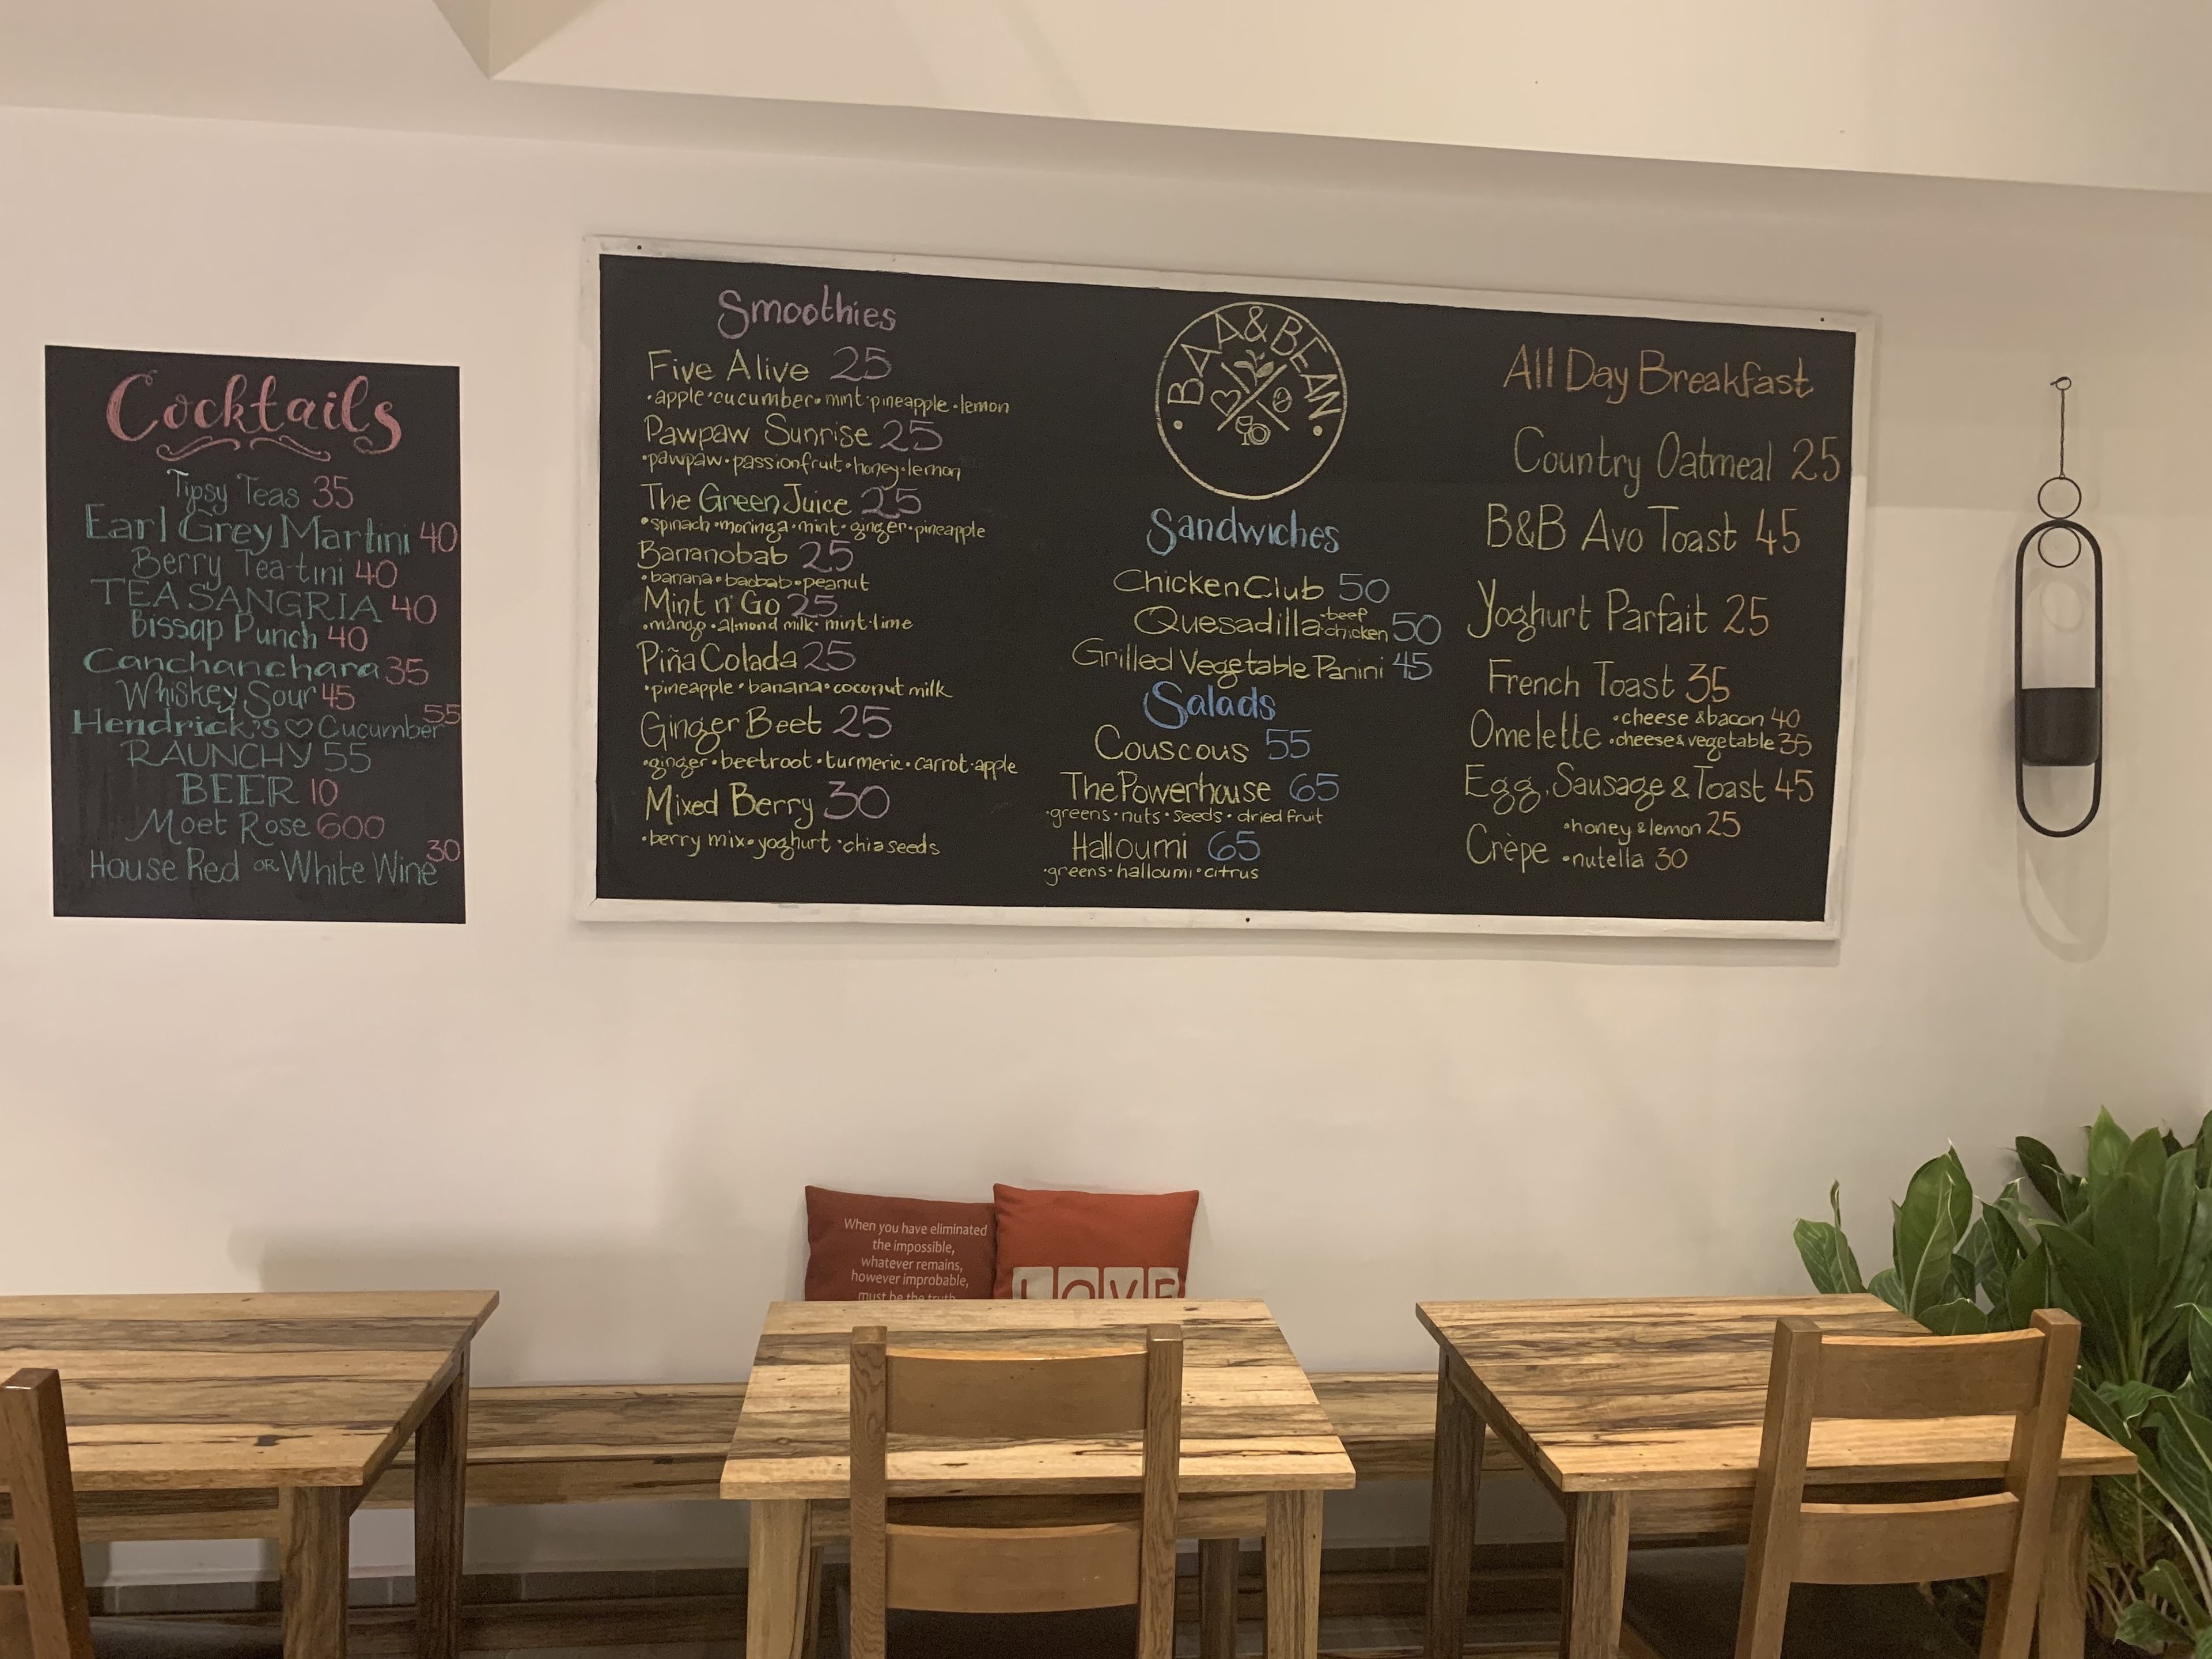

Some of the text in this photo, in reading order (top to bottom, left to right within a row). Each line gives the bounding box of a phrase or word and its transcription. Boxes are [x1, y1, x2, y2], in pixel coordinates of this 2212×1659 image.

[717, 284, 896, 340] Smoothies
[647, 346, 892, 384] Five Alive 25
[1502, 343, 1815, 405] All Day Breakfast
[105, 369, 402, 460] Cocktails
[654, 385, 1010, 418] apple cucumber mint pineapple lemon
[643, 412, 943, 452] Pawpaw Sunrise 25
[649, 450, 900, 490] pawpaw passionfruit honey
[1513, 426, 1840, 499] Country Oatmeal 25
[166, 468, 354, 517] Tipsy Teas 35
[639, 482, 922, 516] The Green Juice 25
[85, 503, 457, 555] Earl Grey Martini 40
[1146, 505, 1340, 556] Sandwiches
[1486, 502, 1801, 556] B&B Avo Toast 45
[131, 546, 222, 592] Berry
[355, 559, 398, 589] 40
[798, 539, 854, 573] 25
[90, 578, 437, 624] TEA SANGRIA 40
[644, 585, 838, 624] Mint Go 25
[1112, 569, 1391, 604] Chicken Club 50
[1133, 605, 1442, 646] Quesadilla 50
[1466, 578, 1770, 643] Yoghurt Parfait 25
[131, 609, 369, 652] Bissap Punch 40
[385, 656, 429, 686] 35
[635, 639, 857, 676] Piña Colada 25
[1071, 637, 1433, 690] Grilled Vegetable Panini 45
[116, 672, 356, 719] Whiskey Sour 45
[1488, 658, 1731, 704] French Toast 35
[318, 714, 445, 740] Cucumber
[423, 703, 458, 725] 55
[1142, 680, 1277, 730] Salads
[1621, 704, 1801, 730] cheese bacon 40
[640, 704, 893, 755] Ginger Beet 25
[1094, 724, 1312, 763] Couscous 55
[1469, 708, 1602, 750] Omelette
[1615, 730, 1813, 762] cheese vegetable 35
[120, 739, 372, 773] RAUNCHY 55
[647, 747, 1018, 781] ginger beetroot turmeric carrot apple
[176, 772, 339, 808] BEER 10
[645, 780, 891, 830] Mixed Berry 30
[1059, 769, 1339, 805] The Powerhouse 65
[1552, 761, 1666, 812] Sausage
[1693, 764, 1767, 803] Toast
[1774, 767, 1815, 803] 45
[125, 808, 385, 847] Moet Rose 600
[1050, 806, 1324, 829] greens nuts seeds dried fruit
[1571, 810, 1741, 846] honey lemon 25
[90, 838, 460, 886] House Red White Wine 30
[649, 829, 941, 861] berry mix yoghurt chia seeds
[1071, 830, 1261, 862] Halloumi 65
[1572, 846, 1688, 872] nutella 30
[1048, 862, 1259, 887] greens halloumi citrus
[844, 1218, 988, 1236] When you have eliminated
[861, 1256, 963, 1273] whatever remains,
[873, 1239, 955, 1255] the impossible,
[851, 1270, 969, 1289] however improbable,
